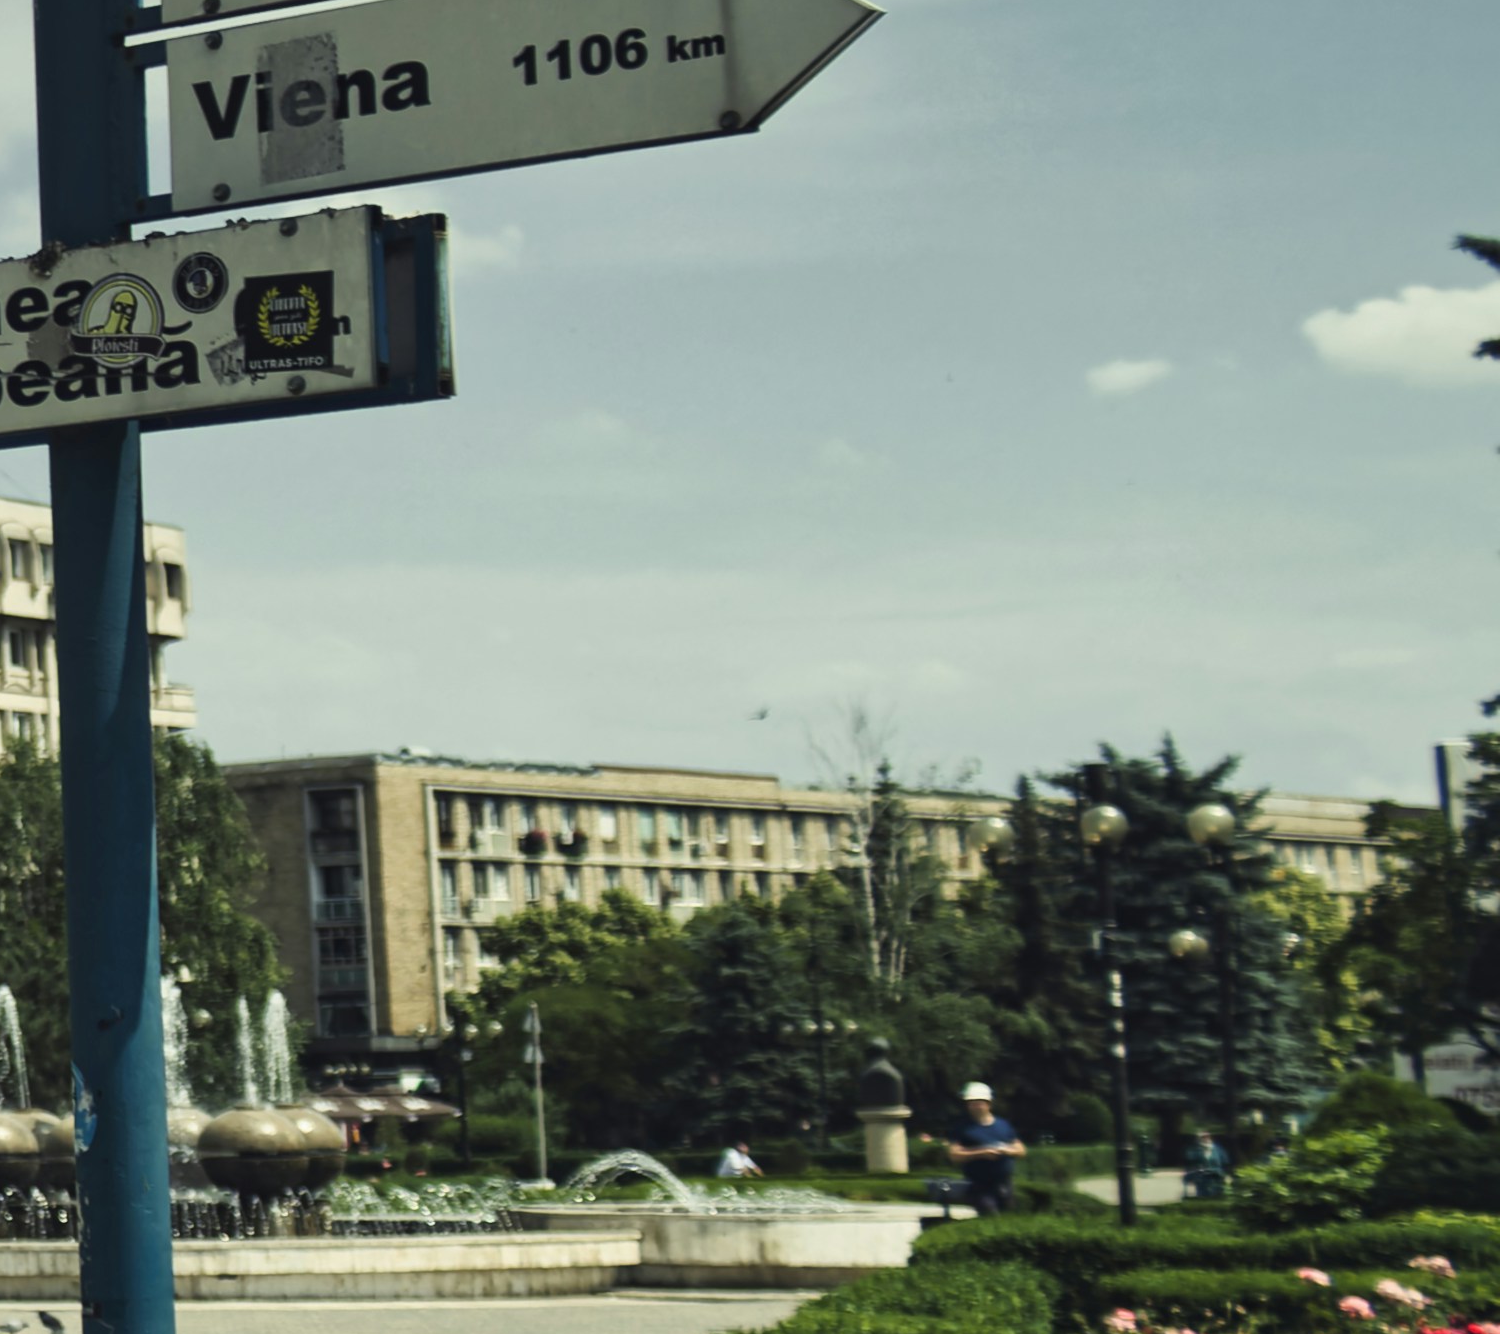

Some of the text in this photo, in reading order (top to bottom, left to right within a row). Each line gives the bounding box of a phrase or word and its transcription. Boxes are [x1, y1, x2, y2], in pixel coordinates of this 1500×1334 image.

[193, 27, 727, 141] Viena 1106 km
[249, 356, 325, 370] ULTRAS-TIFO
